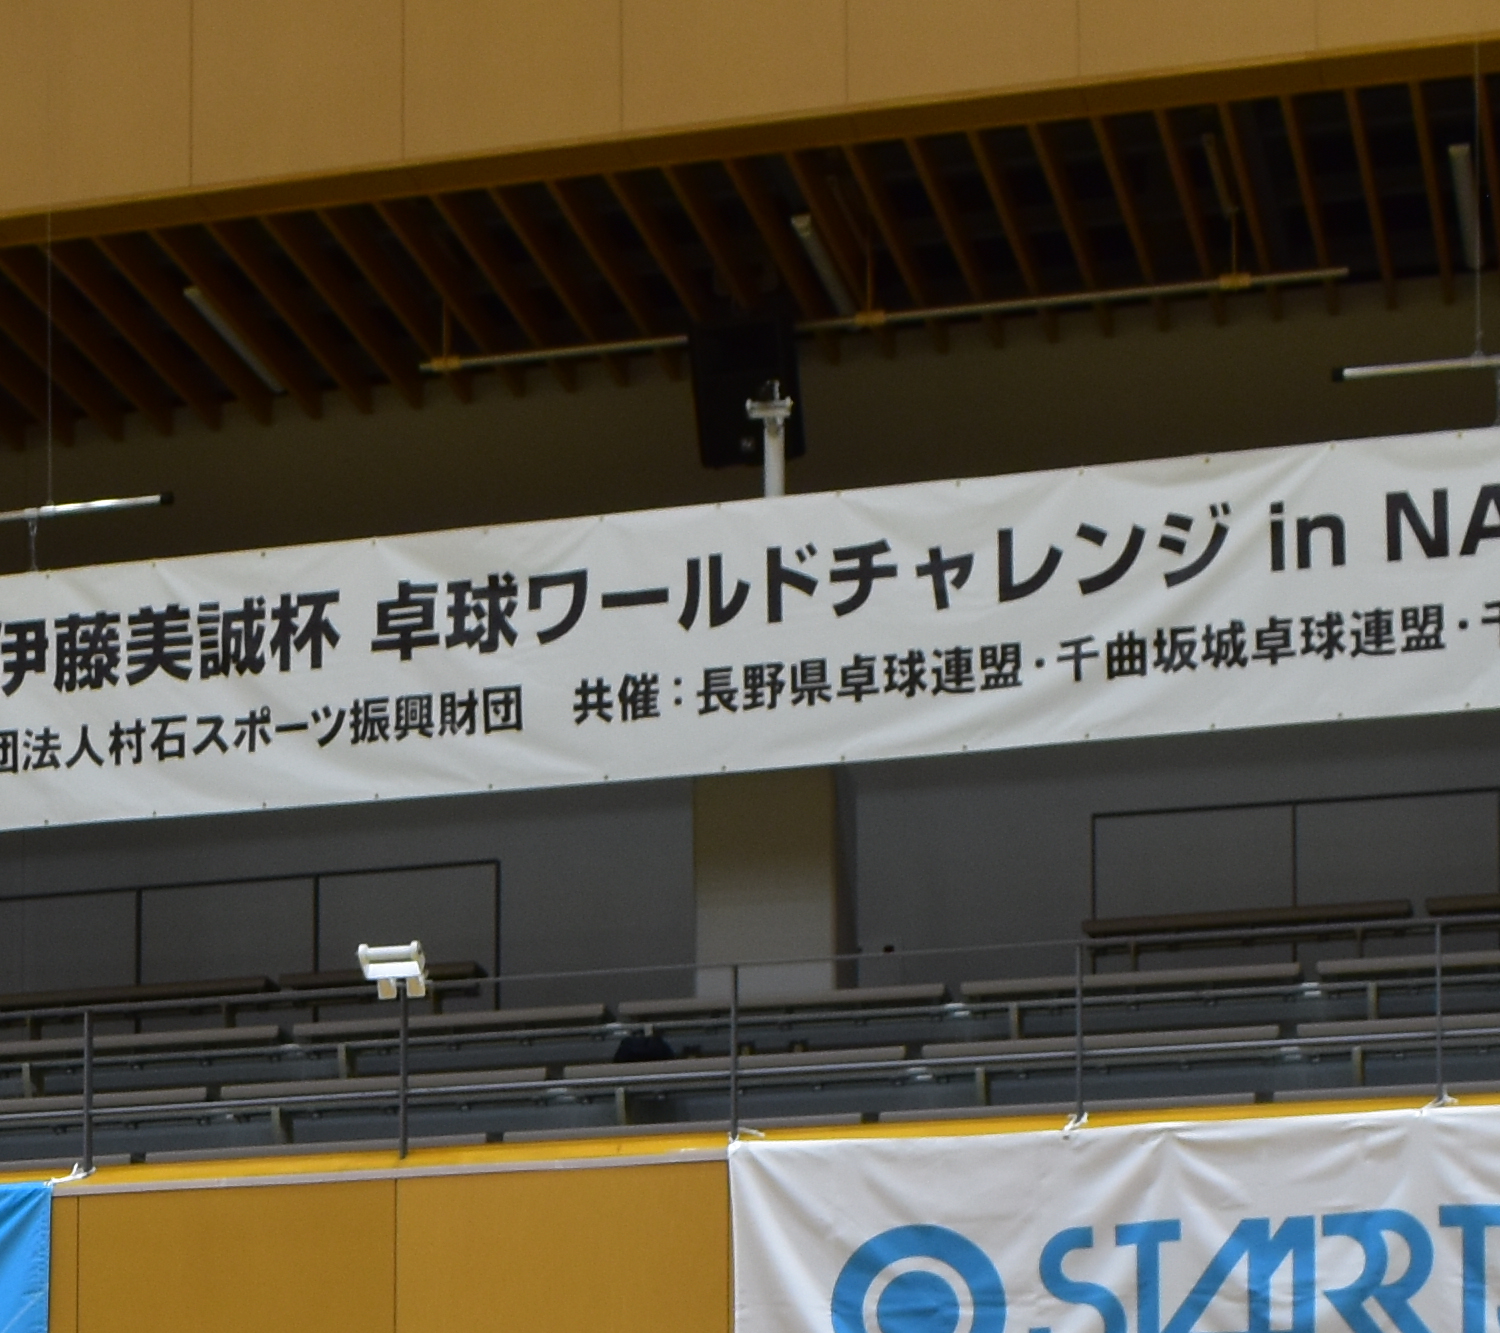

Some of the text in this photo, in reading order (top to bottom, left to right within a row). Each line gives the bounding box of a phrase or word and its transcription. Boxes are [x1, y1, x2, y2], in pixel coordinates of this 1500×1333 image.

[371, 502, 1230, 660] 卓球ワールドチャレンジ
[1269, 501, 1347, 572] in
